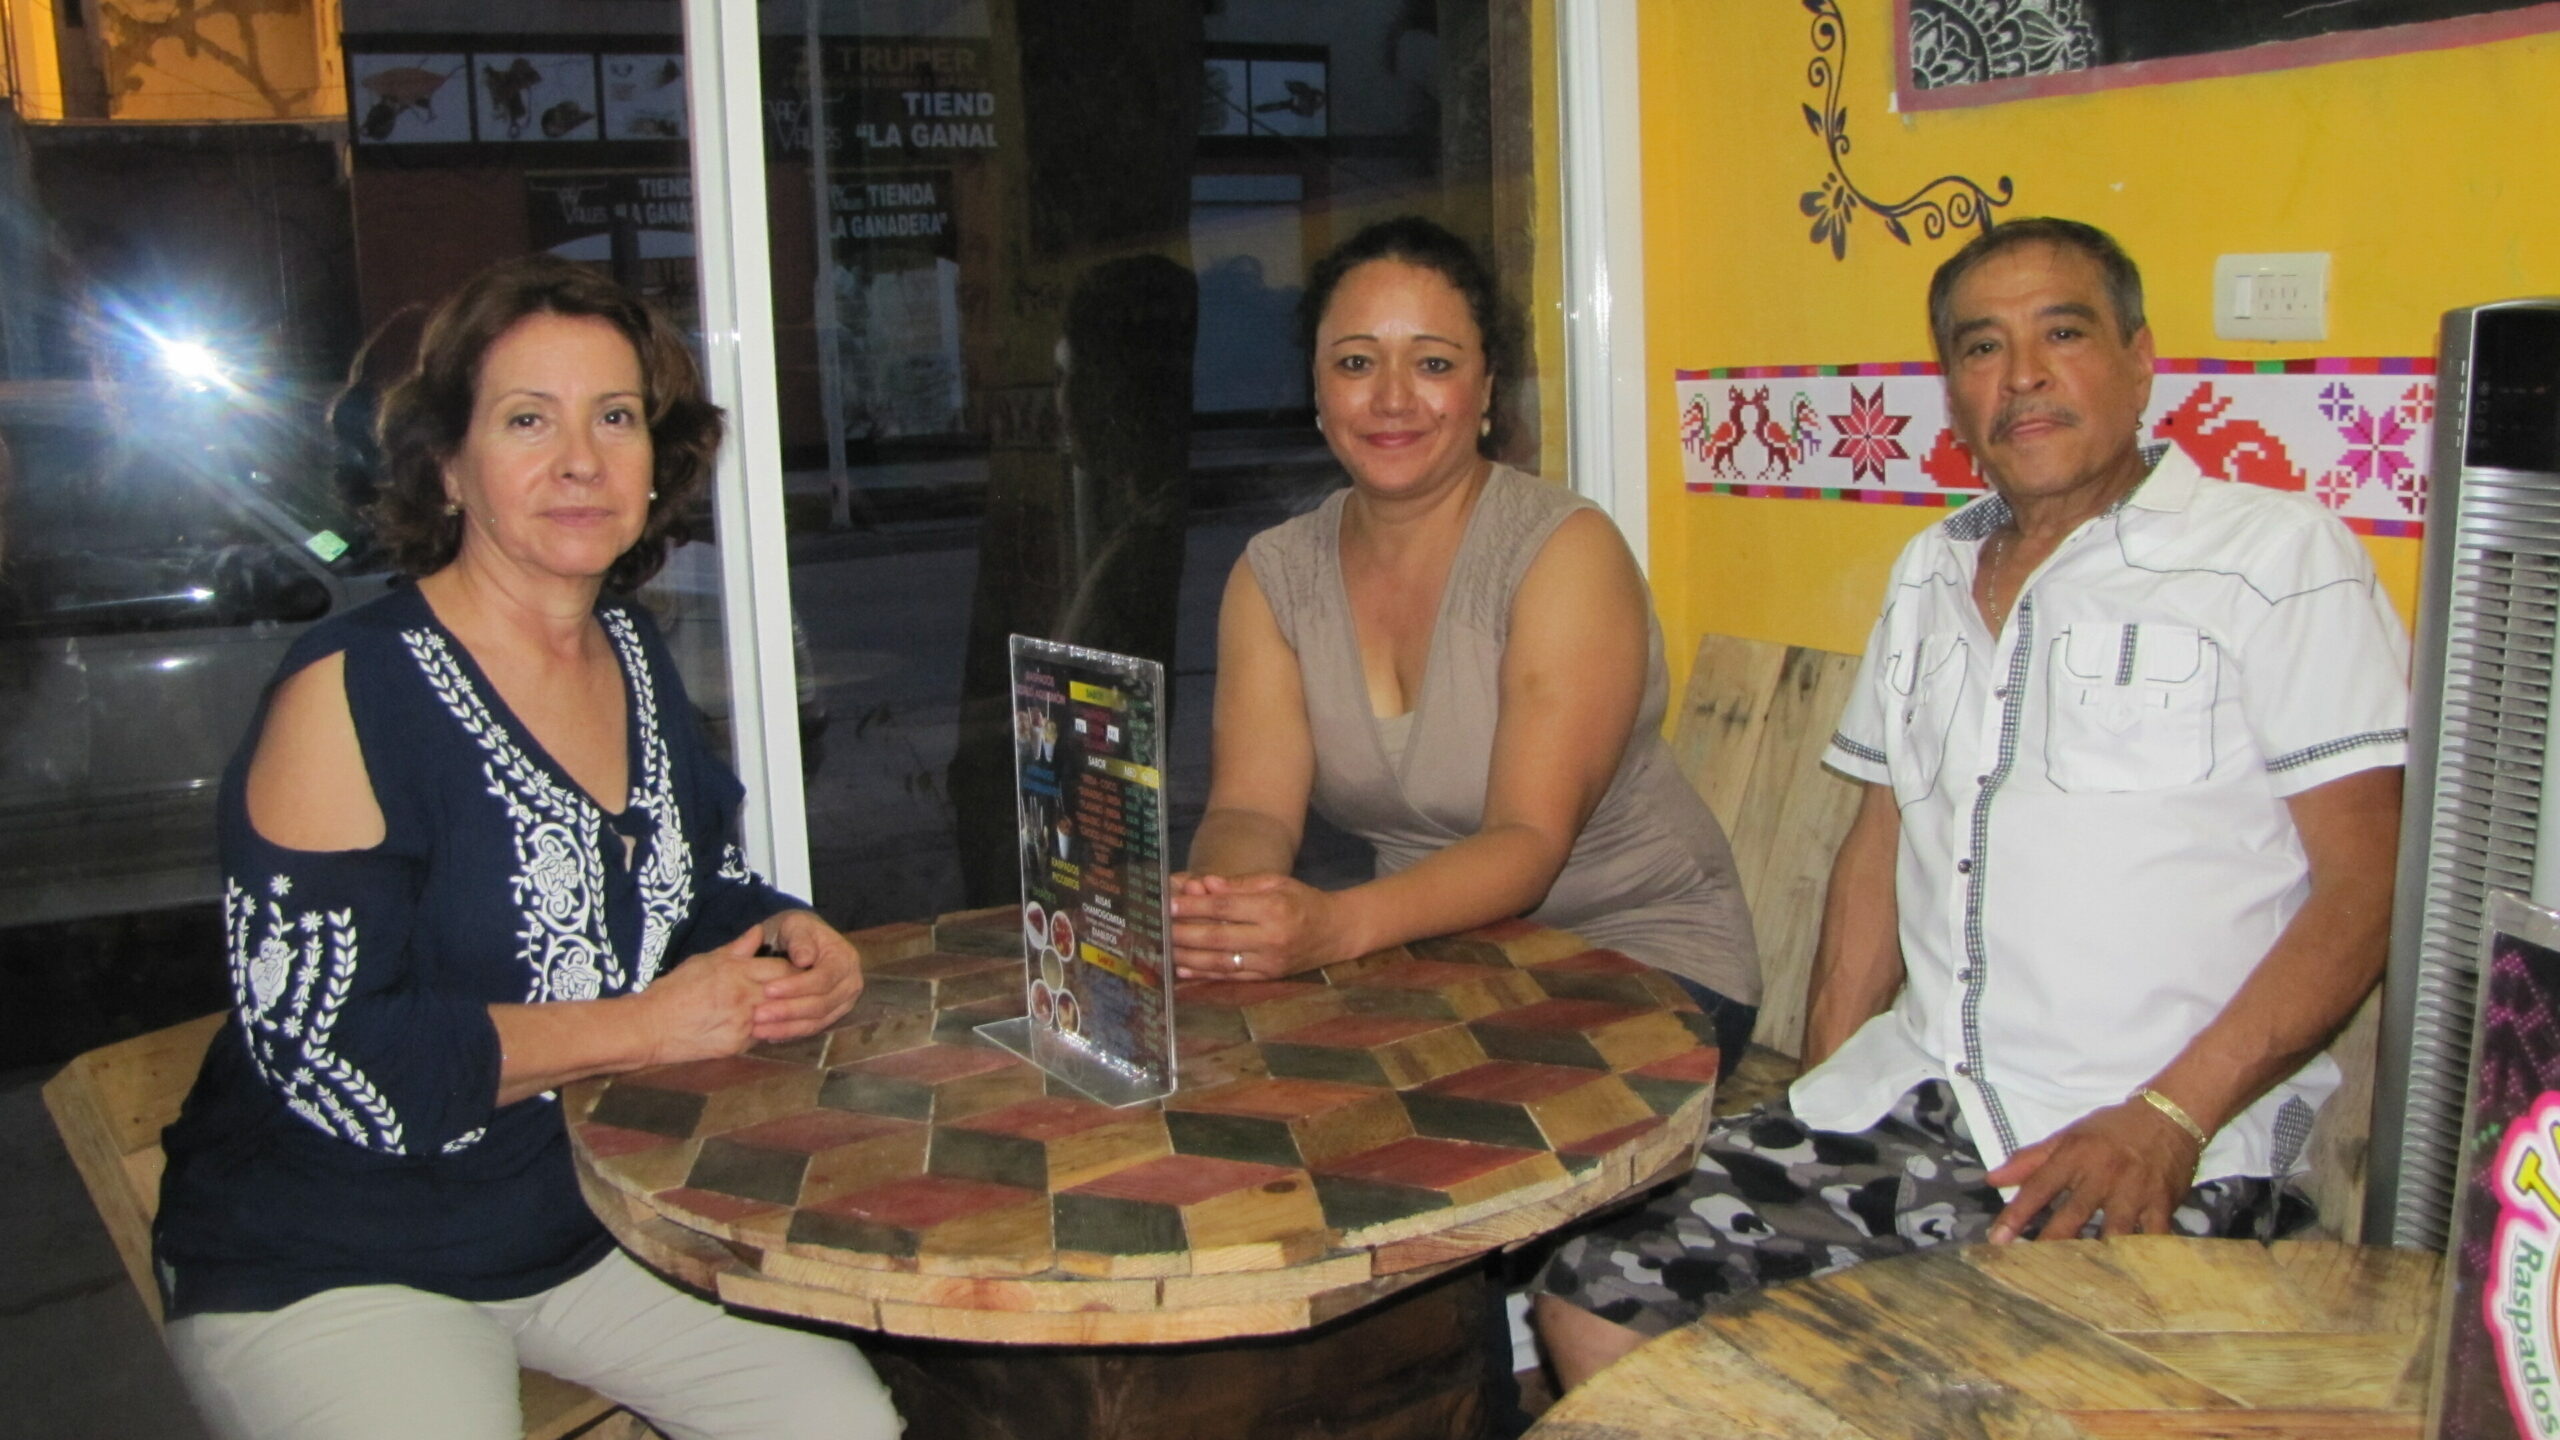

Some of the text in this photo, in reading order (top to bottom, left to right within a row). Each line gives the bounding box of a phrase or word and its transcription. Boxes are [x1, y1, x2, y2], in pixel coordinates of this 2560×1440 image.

[835, 46, 977, 73] TRUPER
[866, 183, 936, 207] TIENDA
[2506, 1239, 2559, 1435] Raspados
